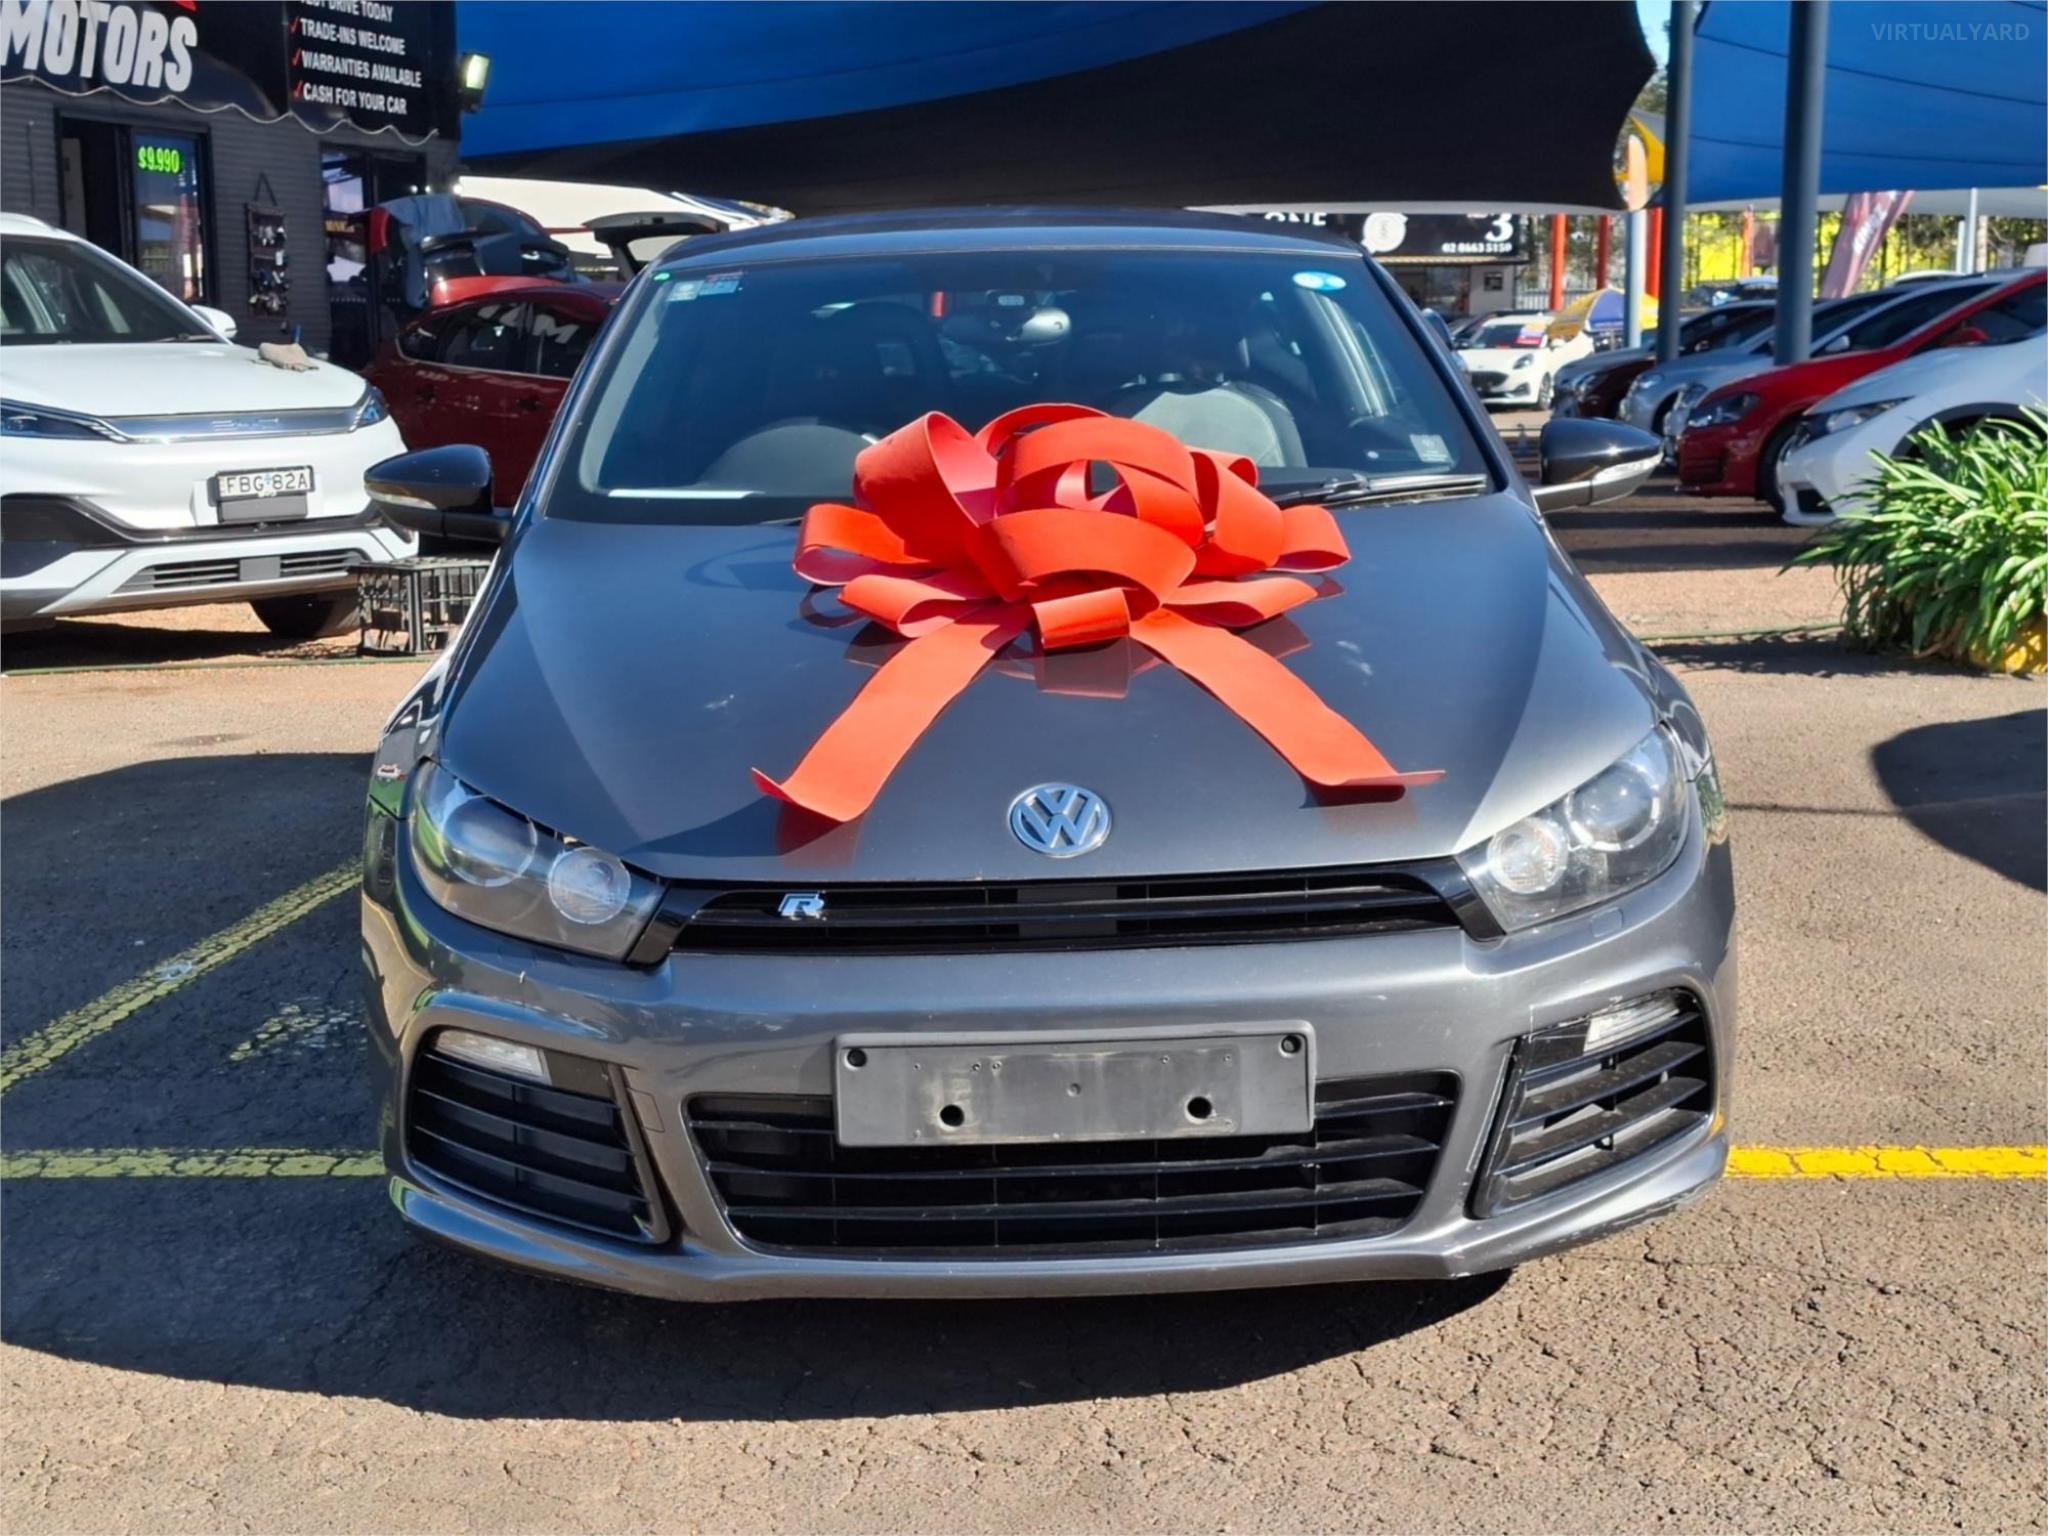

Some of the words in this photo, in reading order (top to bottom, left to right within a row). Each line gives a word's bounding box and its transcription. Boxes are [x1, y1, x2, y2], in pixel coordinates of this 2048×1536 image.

[361, 1, 394, 22] TODAY
[0, 1, 197, 92] MOTORS
[300, 18, 357, 45] TRADE-INS
[358, 30, 405, 55] WELCOME
[302, 50, 370, 79] WARRANTIES
[371, 63, 422, 87] AVAILABLE
[303, 82, 334, 103] CASH
[335, 87, 357, 107] FOR
[358, 91, 386, 112] YOUR
[386, 96, 407, 114] CAR
[226, 476, 264, 493] FBG
[272, 472, 308, 490] 82A
[778, 893, 826, 920] R
